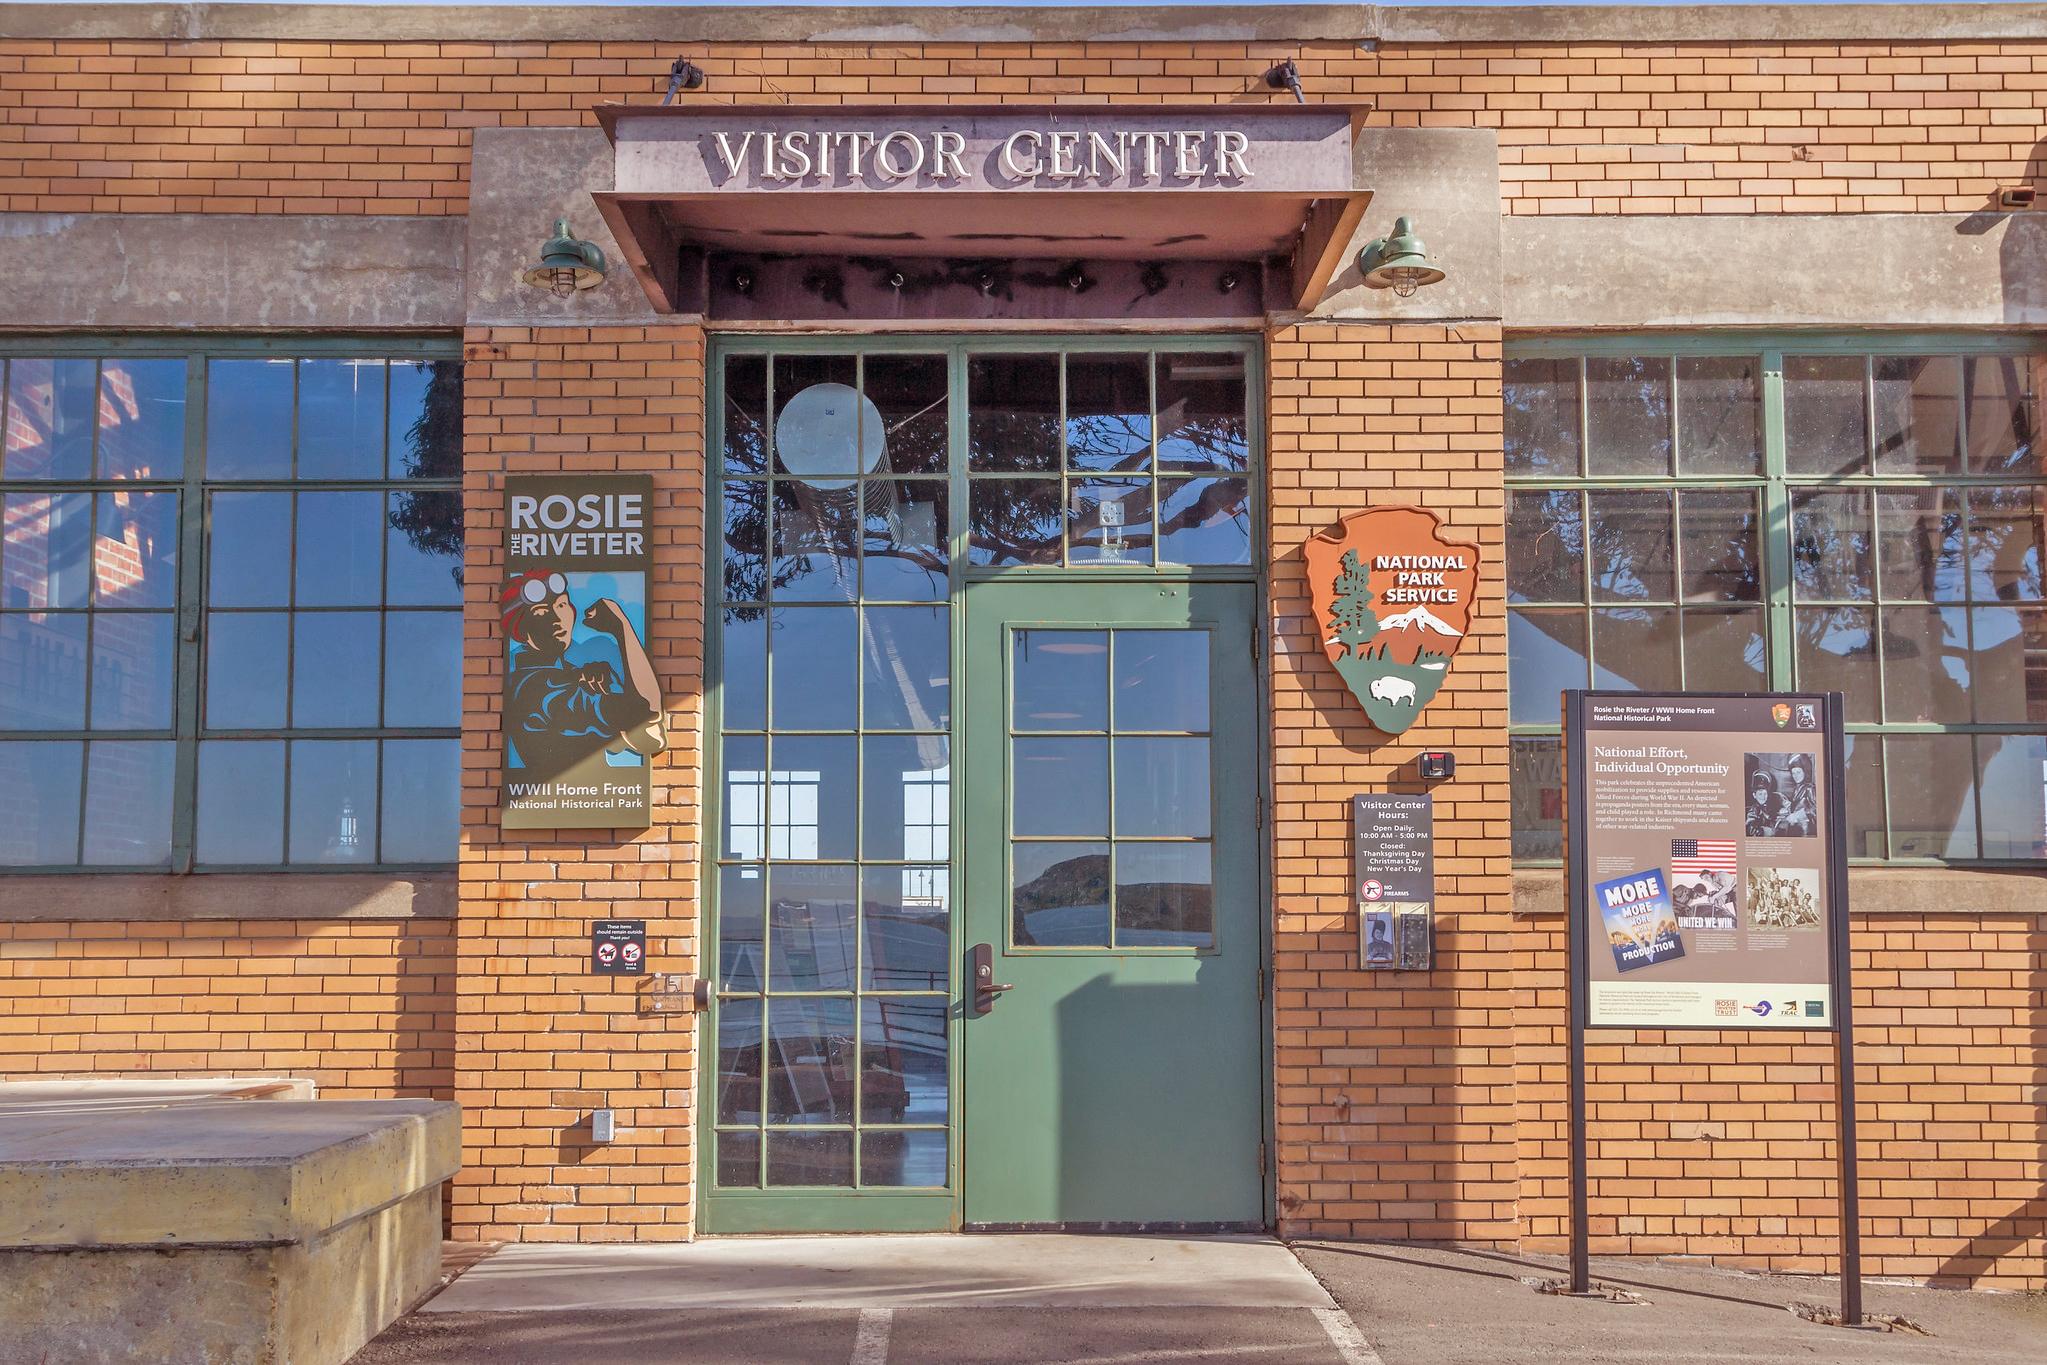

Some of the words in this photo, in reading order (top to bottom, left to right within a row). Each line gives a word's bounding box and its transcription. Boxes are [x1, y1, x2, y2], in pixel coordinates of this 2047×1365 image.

[712, 131, 971, 177] VISITOR
[1004, 130, 1254, 177] CENTER
[511, 494, 643, 529] ROSIE
[511, 533, 521, 556] THE
[521, 532, 644, 556] RIVETER
[1376, 555, 1467, 569] NATIONAL
[1399, 572, 1444, 585] PARK
[1386, 589, 1457, 602] SERVICE
[1595, 746, 1646, 758] National
[1649, 747, 1688, 760] Effort,
[1595, 762, 1654, 772] Individual
[1656, 762, 1729, 776] Opportunity
[509, 783, 551, 795] WWII
[556, 783, 598, 795] Home
[604, 783, 642, 795] Front
[509, 799, 557, 809] National
[561, 799, 614, 809] Historical
[619, 798, 643, 808] Park
[1604, 877, 1660, 906] MORE
[1622, 902, 1652, 918] MORE
[1678, 916, 1704, 928] UNITED
[1704, 916, 1716, 928] WE
[1718, 916, 1732, 928] WIN
[1622, 940, 1675, 960] PRODUCTION
